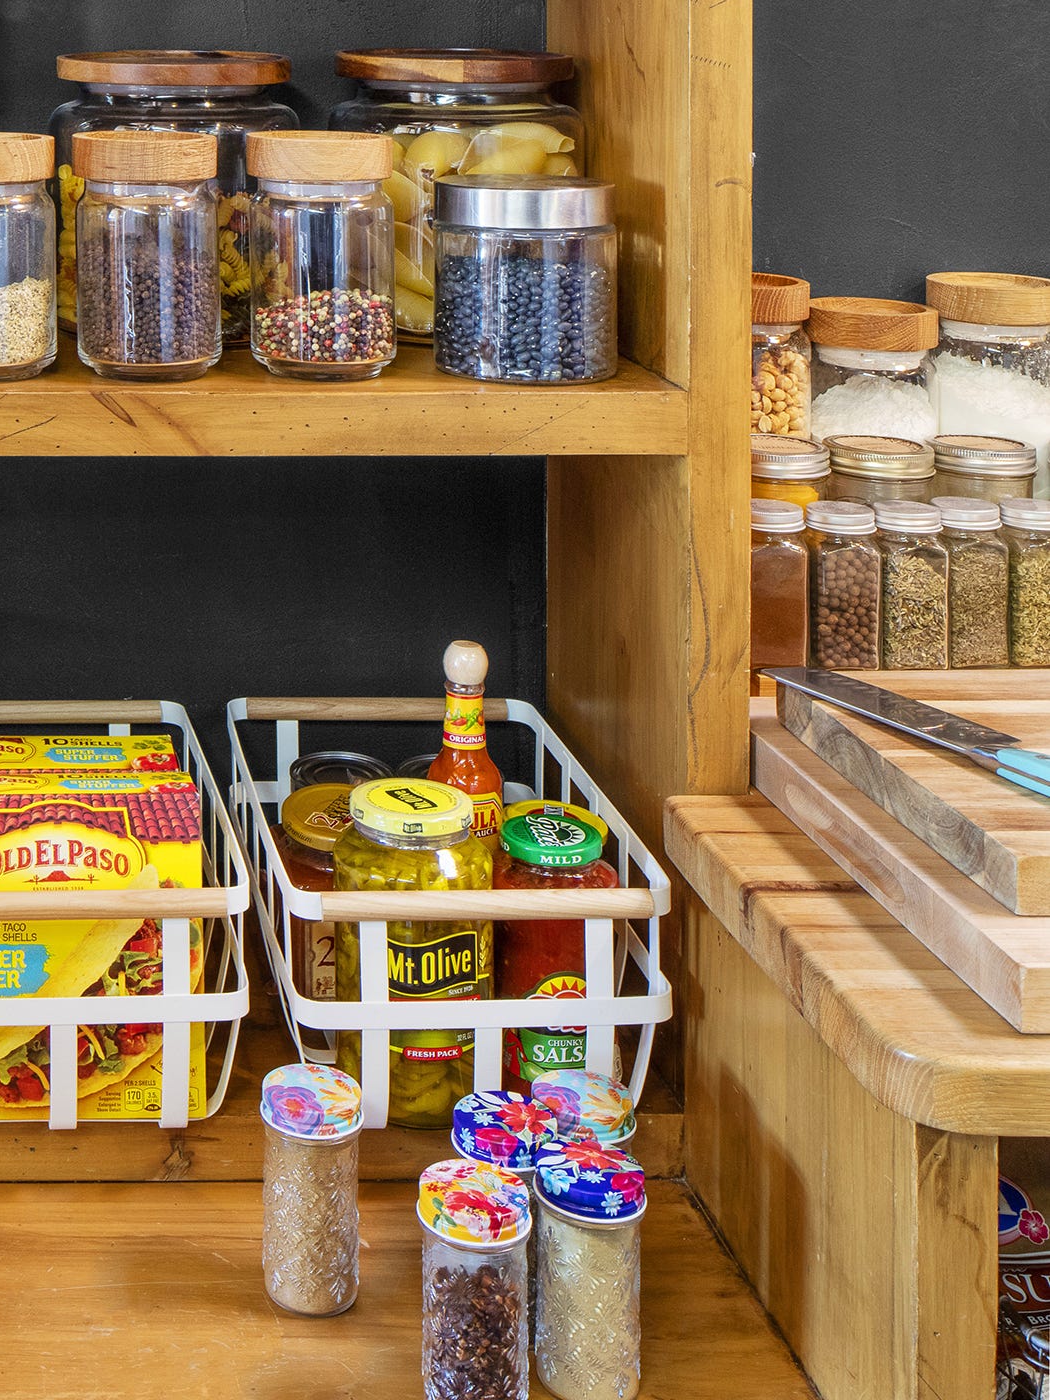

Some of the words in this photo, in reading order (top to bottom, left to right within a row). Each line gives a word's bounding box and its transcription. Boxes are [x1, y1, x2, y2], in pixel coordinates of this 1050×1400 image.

[43, 738, 70, 746] 10
[449, 734, 485, 743] ORIGINAL
[55, 748, 95, 756] SUPER
[63, 754, 120, 762] STUFFER
[475, 828, 494, 839] AUCE
[35, 839, 67, 867] EL
[540, 855, 583, 865] MILD
[2, 922, 27, 932] TACO
[2, 932, 38, 942] SHELLS
[316, 935, 335, 967] 2
[388, 948, 419, 985] Mt.
[421, 947, 471, 985] Olive
[548, 1039, 583, 1047] CHUNKY
[407, 1049, 436, 1058] FRESH
[437, 1049, 459, 1058] PACK
[532, 1044, 587, 1063] SALS
[127, 1090, 141, 1100] 170
[1028, 1314, 1050, 1327] BRO
